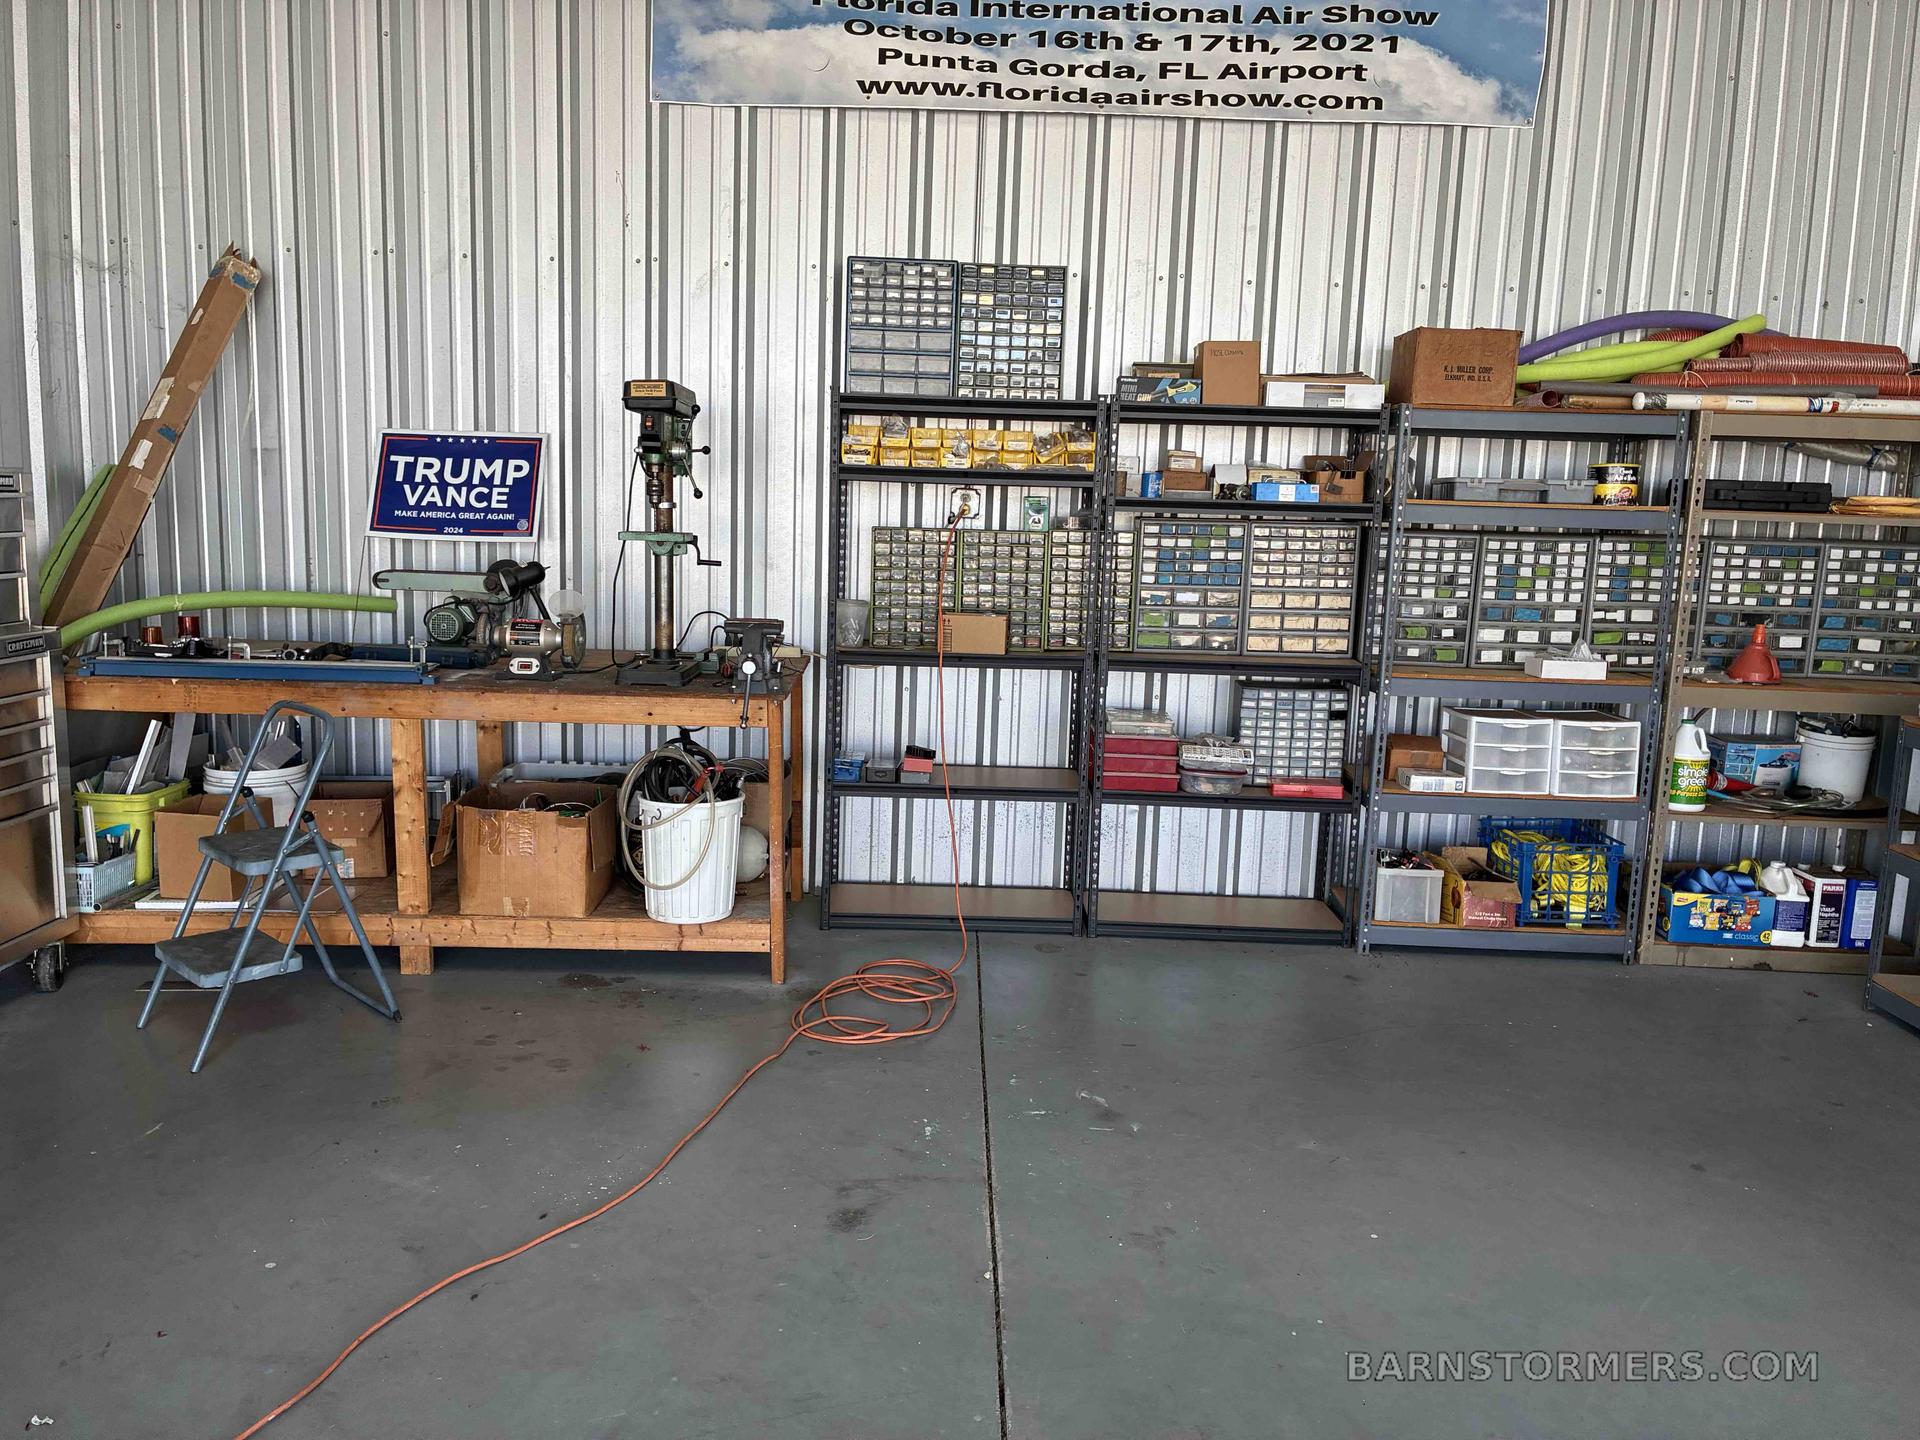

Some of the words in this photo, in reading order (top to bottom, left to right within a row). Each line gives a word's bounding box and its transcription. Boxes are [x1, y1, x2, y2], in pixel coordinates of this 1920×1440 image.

[970, 0, 1243, 25] International
[1251, 5, 1313, 25] Air
[1321, 5, 1439, 26] Show
[844, 18, 1017, 47] October
[1028, 30, 1124, 51] 16th
[1134, 33, 1162, 52] &
[1174, 34, 1280, 55] 17th,
[1292, 33, 1399, 54] 2021
[878, 48, 998, 74] Punta
[1008, 58, 1146, 82] Gorda,
[1158, 63, 1215, 80] FL
[1216, 62, 1368, 83] Airport
[856, 79, 1383, 111] www.floridaairshow.com
[389, 455, 530, 486] TRUMP
[402, 484, 510, 509] VANCE
[394, 510, 418, 518] MAKE
[420, 511, 457, 519] AMERICA
[458, 512, 485, 520] GREAT
[486, 513, 515, 521] AGAIN!
[443, 526, 464, 534] 2024
[8, 637, 44, 652] CRAFTSMAN
[1678, 765, 1708, 779] simple
[1678, 777, 1707, 788] green
